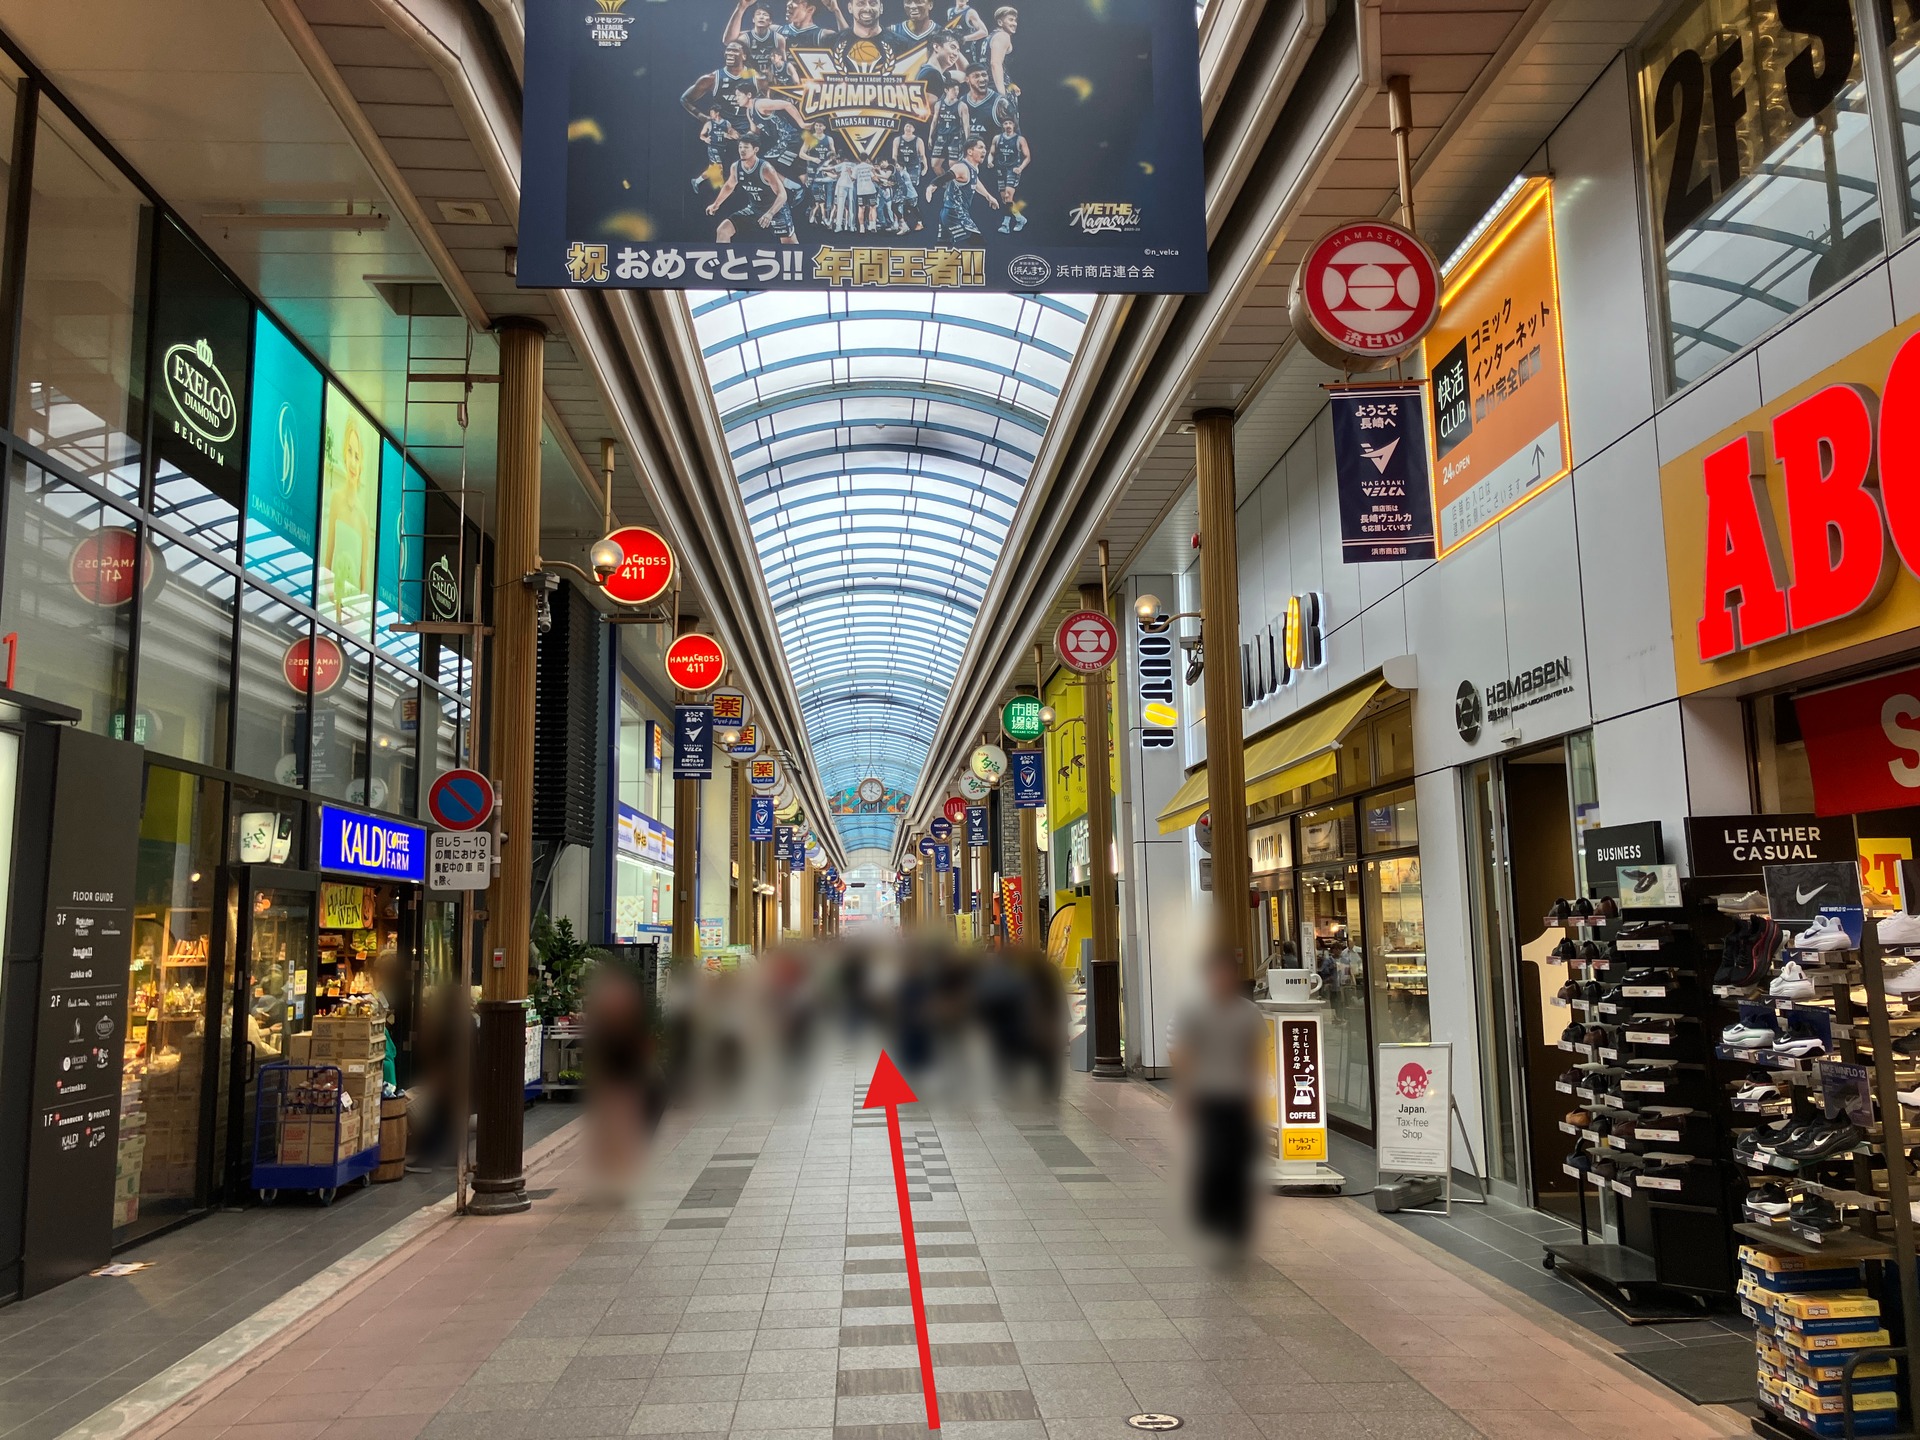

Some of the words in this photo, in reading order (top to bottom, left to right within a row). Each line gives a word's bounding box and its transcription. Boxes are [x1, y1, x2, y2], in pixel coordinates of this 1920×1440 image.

[591, 30, 629, 40] FINALS
[804, 82, 928, 116] CHAMPIONS
[835, 118, 871, 128] NAGASAKI
[873, 118, 895, 128] VELCA
[1069, 207, 1141, 234] Nagasaki
[1333, 231, 1402, 248] HAMASEN
[566, 242, 610, 283] 祝
[615, 248, 804, 281] おめでとう!!
[811, 245, 986, 287] 年間王者!!
[1056, 265, 1155, 278] 浜市商店連合会
[1471, 298, 1511, 354] コミック
[1473, 301, 1550, 387] インターネット
[173, 355, 231, 419] EXELCO
[1438, 360, 1464, 411] 快活
[184, 391, 220, 428] DIAMOND
[1355, 404, 1399, 417] ようこそ
[1360, 417, 1396, 430] 長崎へ
[1440, 400, 1467, 438] CLUB
[174, 420, 225, 466] BELGIUM
[1455, 454, 1471, 475] OPEN
[1362, 487, 1406, 497] VELCA
[251, 494, 283, 526] DIAMOND
[1360, 513, 1412, 523] 長崎ヴェルカ
[621, 567, 645, 579] 411
[670, 654, 720, 663] HAMACROSS
[686, 664, 704, 673] 411
[715, 697, 741, 717] 薬
[1724, 827, 1821, 844] LEATHER
[341, 819, 386, 869] KALDI
[386, 830, 409, 852] COFFEE
[387, 850, 409, 871] FARM
[434, 849, 486, 860] の間における
[1597, 845, 1641, 861] BUSINESS
[1733, 845, 1818, 861] CASUAL
[73, 891, 93, 901] FLOOR
[94, 892, 114, 902] GUIDE
[57, 913, 67, 926] 3F
[51, 995, 61, 1008] 2F
[1303, 1028, 1311, 1063] コーヒー豆
[1859, 1070, 1866, 1078] 12
[44, 1113, 54, 1127] 1F
[59, 1115, 84, 1127] STARBUCKS
[93, 1108, 111, 1120] PRONTO
[1396, 1117, 1429, 1127] Tax-free
[61, 1133, 79, 1147] KALDI
[1402, 1129, 1422, 1140] Shop
[1834, 1304, 1876, 1312] SKECHERS
